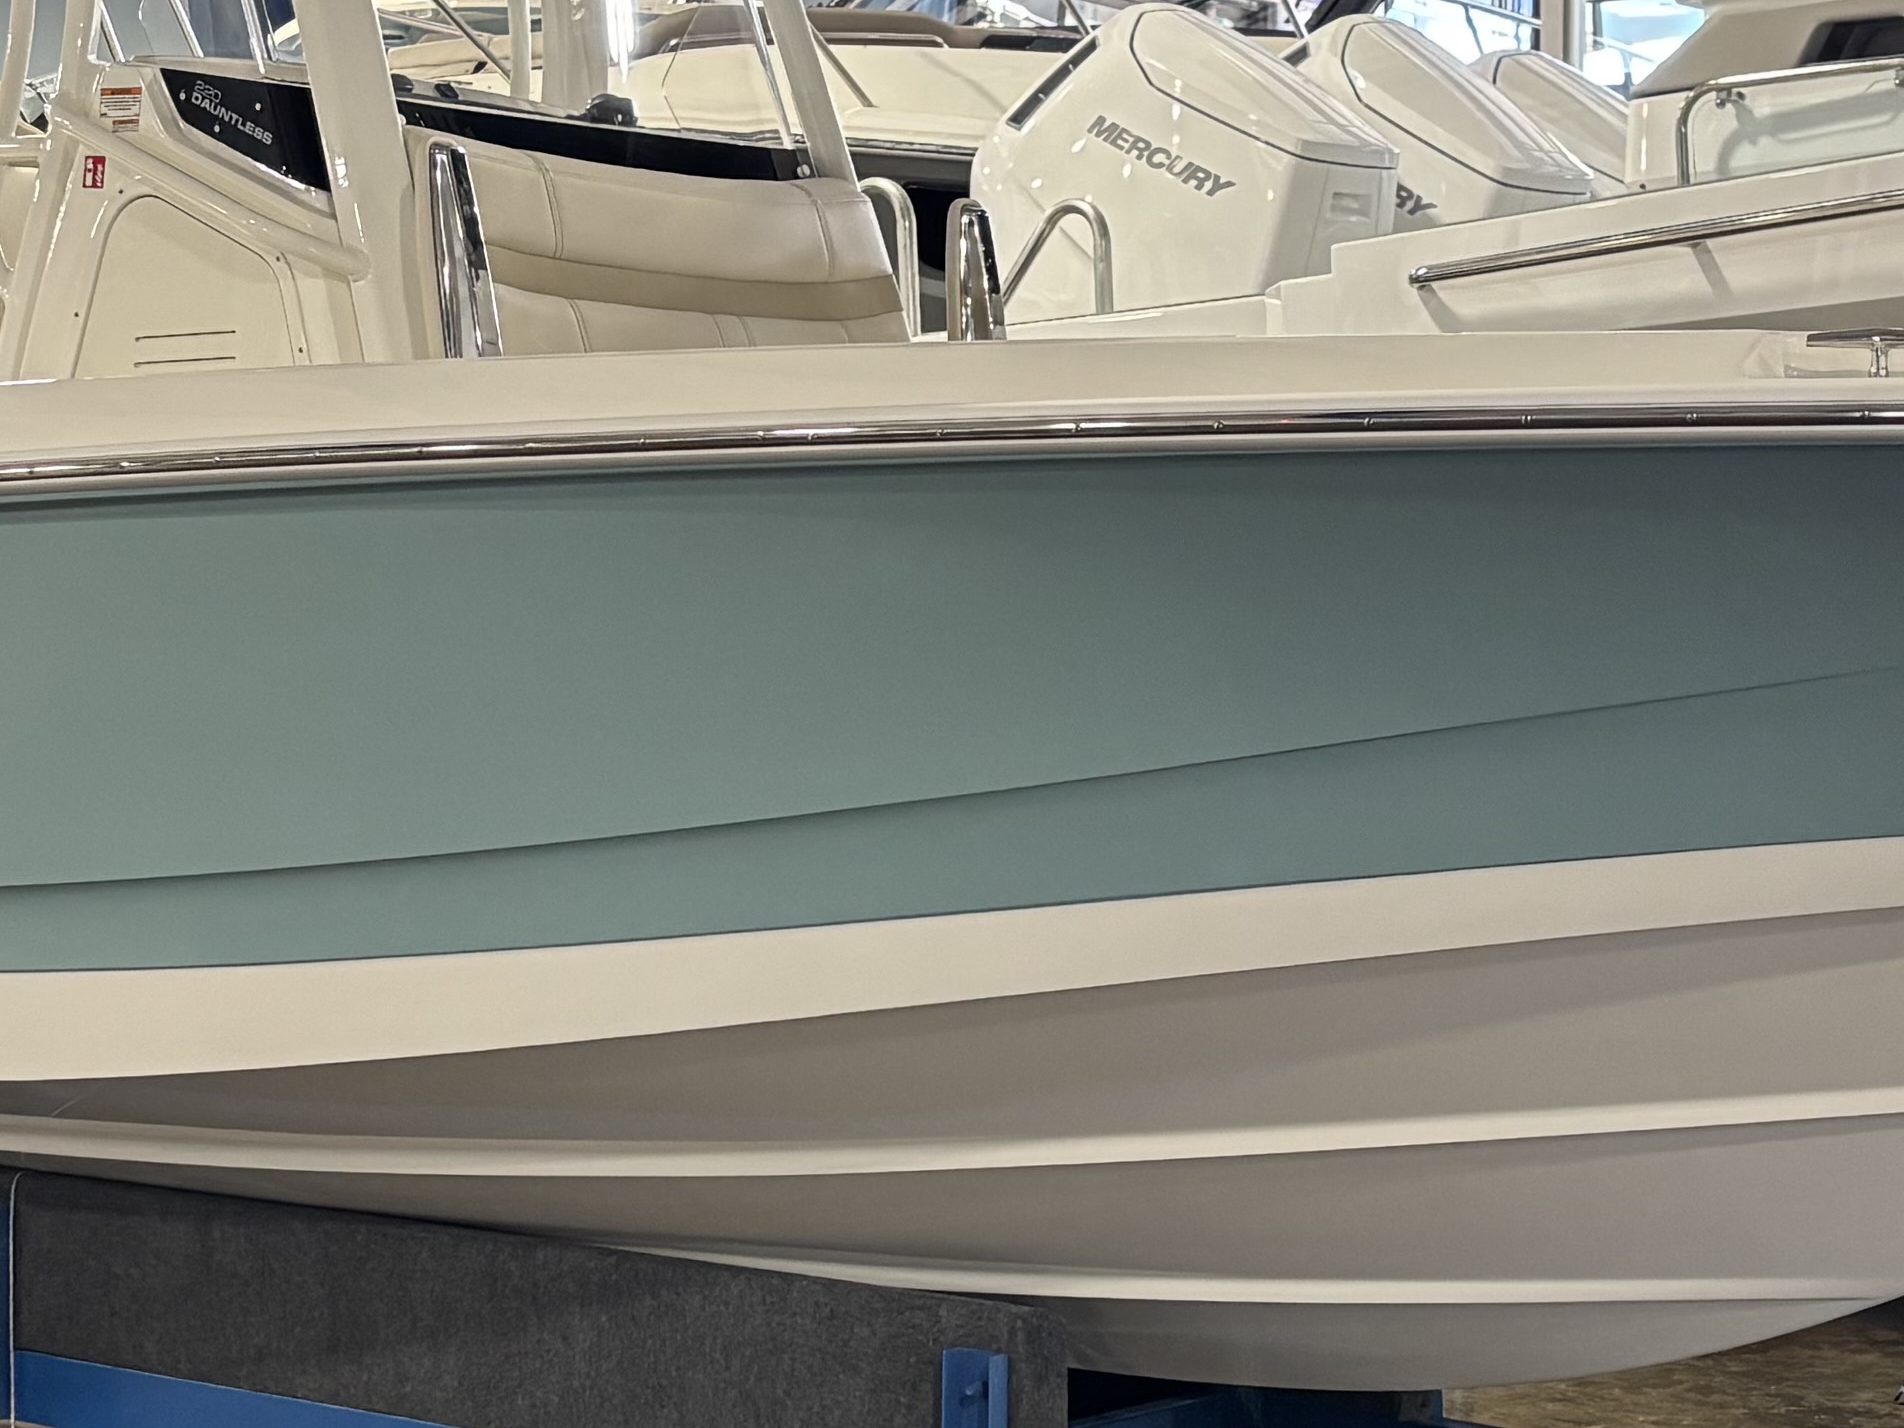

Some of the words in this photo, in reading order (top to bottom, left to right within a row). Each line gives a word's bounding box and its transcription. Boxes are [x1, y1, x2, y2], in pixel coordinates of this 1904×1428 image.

[195, 80, 222, 103] 220
[191, 92, 273, 145] DAUNTLESS
[1086, 115, 1236, 197] MERCURY
